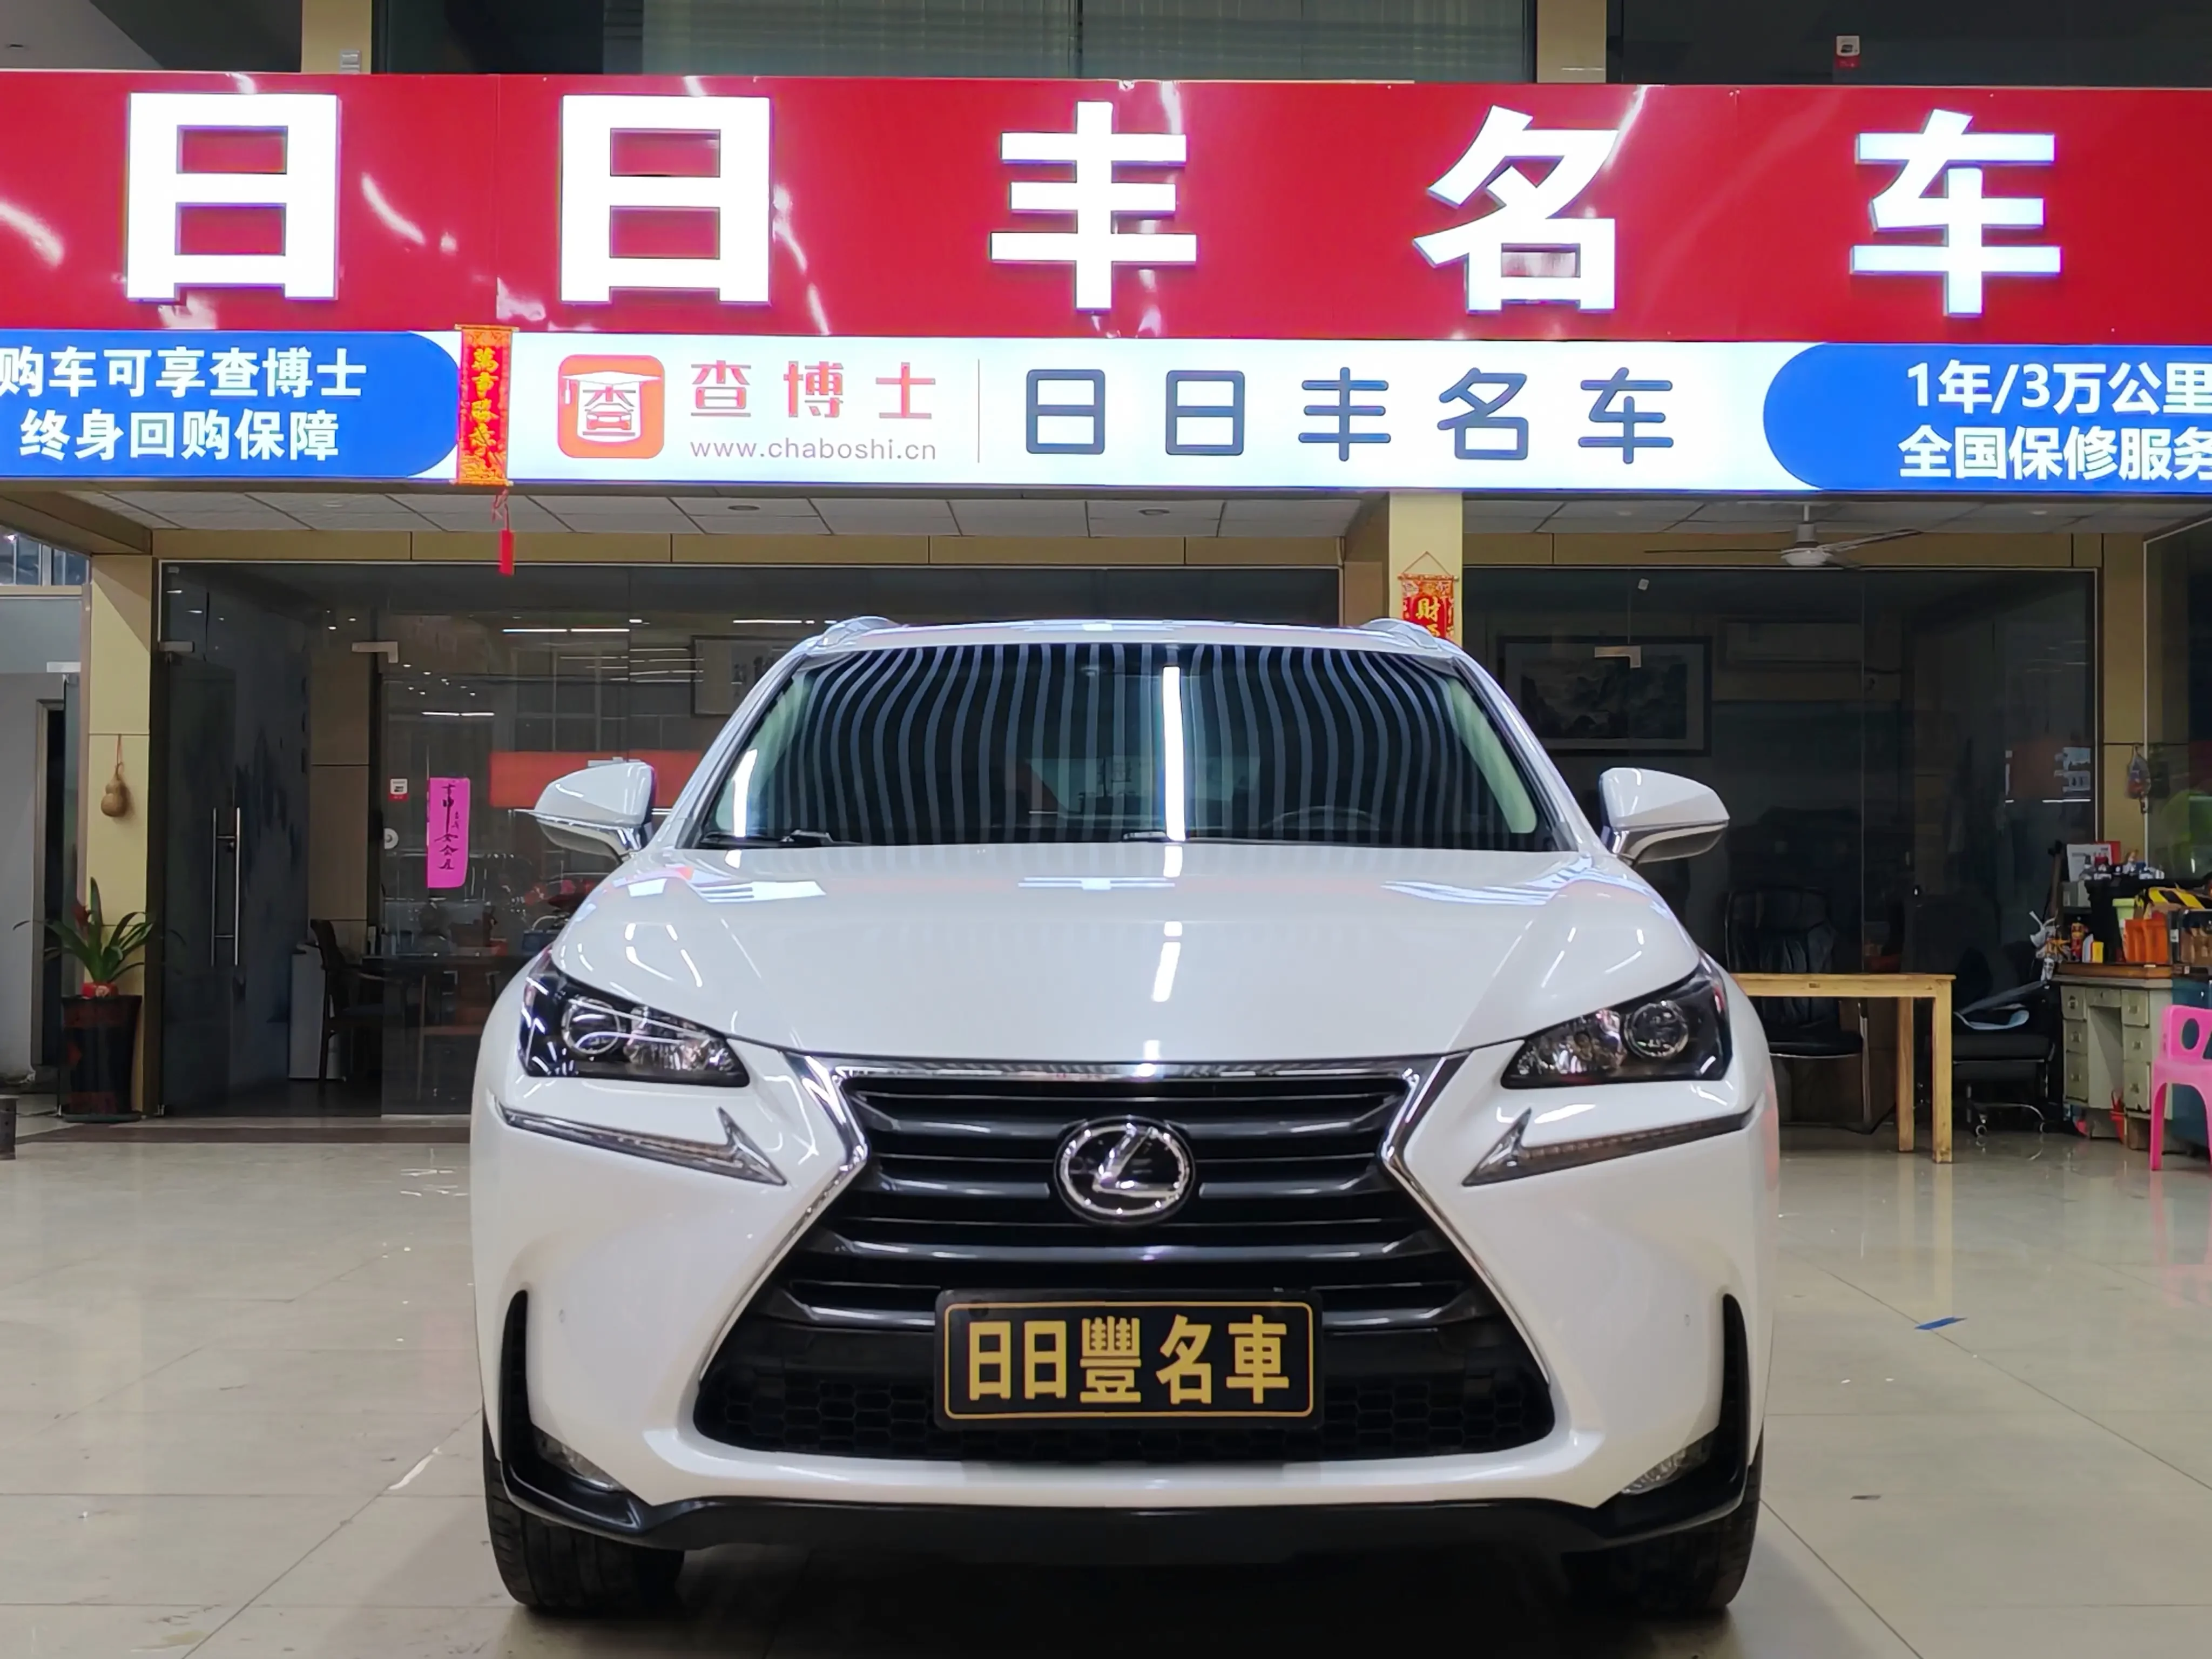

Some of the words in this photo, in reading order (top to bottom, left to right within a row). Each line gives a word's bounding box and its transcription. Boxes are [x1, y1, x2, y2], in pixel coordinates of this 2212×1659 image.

[125, 93, 2061, 314] 日日丰名车
[0, 346, 367, 398] 购车可享查博士
[691, 360, 935, 419] 查博士
[1907, 359, 2212, 415] 1年/3万公里
[19, 408, 339, 461] 终身回购保障
[1026, 367, 1674, 464] 日日丰名车
[690, 437, 935, 460] www.chaboshi.cn
[1898, 425, 2212, 481] 全国保修服务
[969, 1314, 1289, 1404] 日日豐名車
